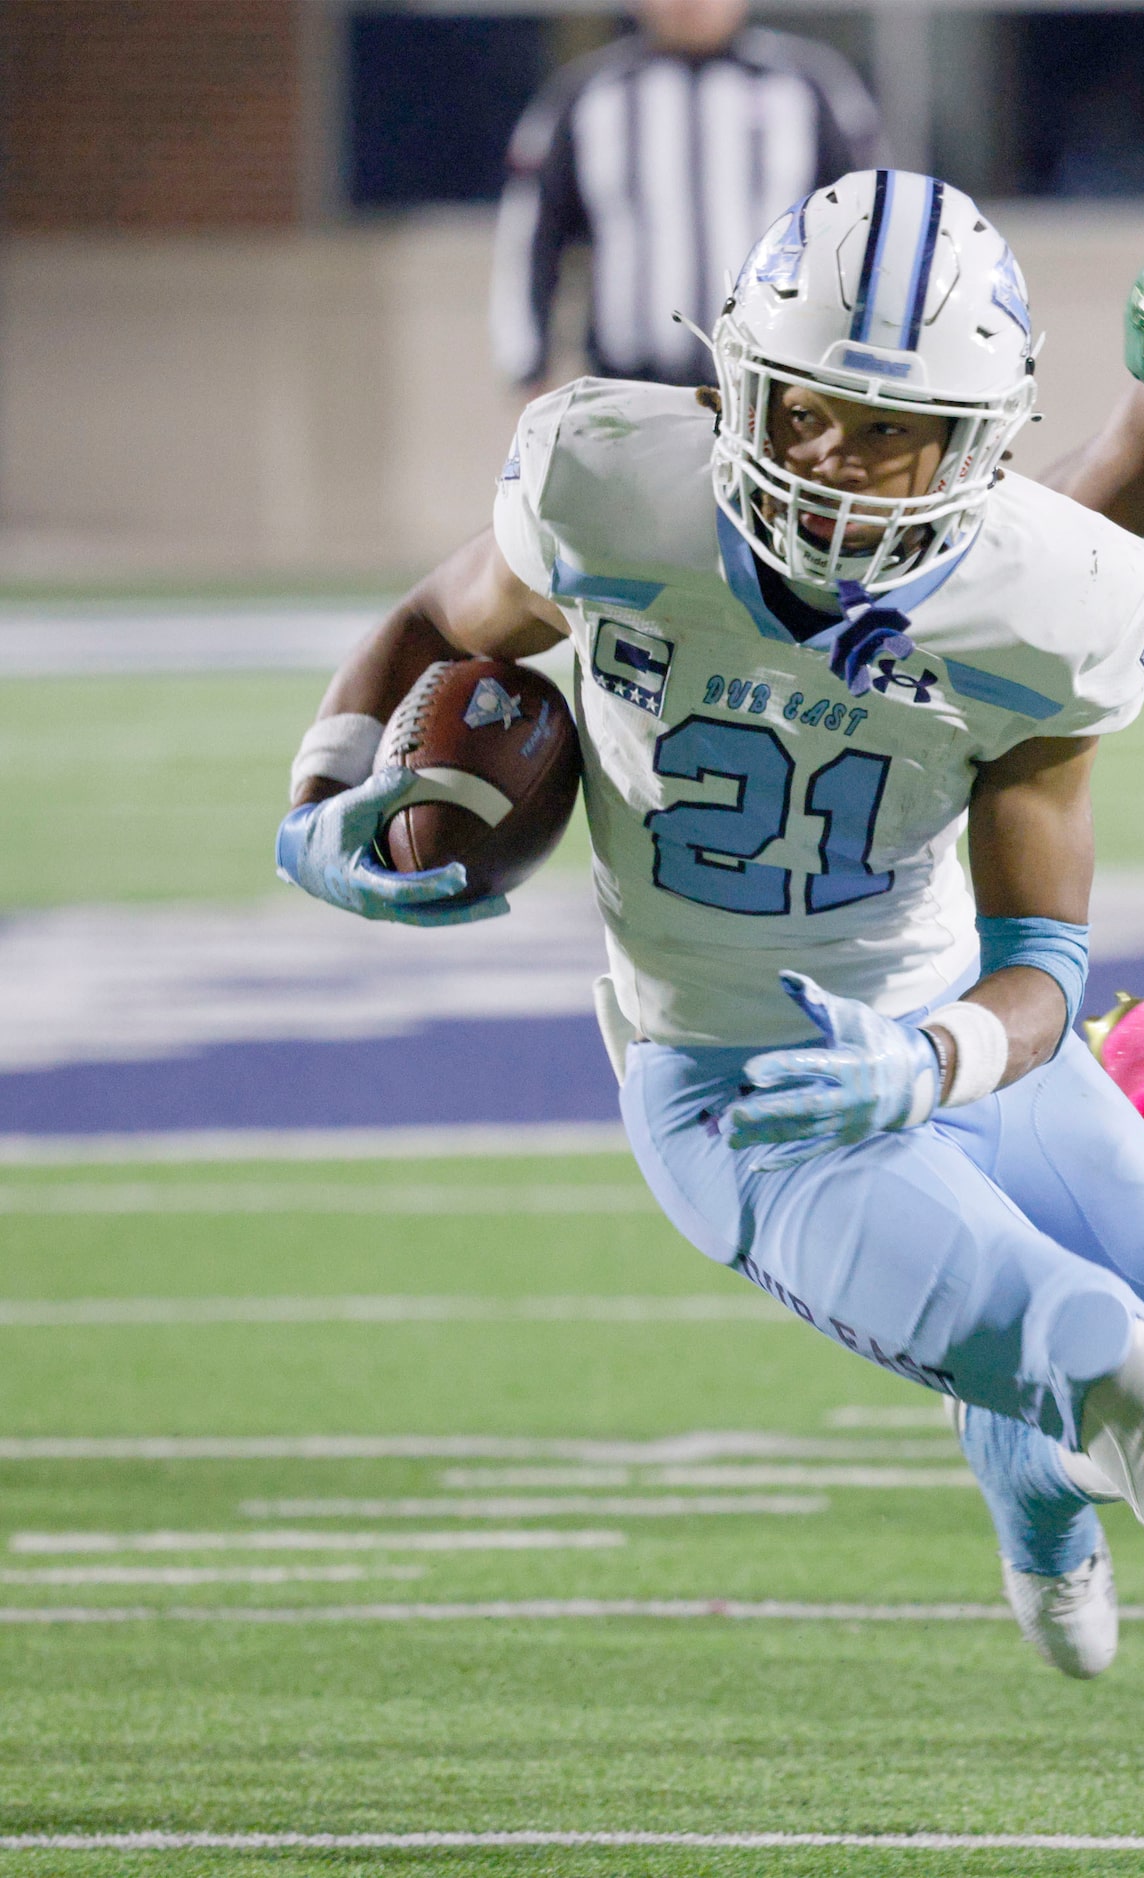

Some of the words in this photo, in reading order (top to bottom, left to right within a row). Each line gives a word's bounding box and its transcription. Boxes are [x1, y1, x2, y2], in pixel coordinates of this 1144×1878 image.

[803, 550, 843, 572] Riddll
[702, 673, 772, 715] DUB
[782, 691, 869, 737] EAST
[643, 713, 895, 916] 21
